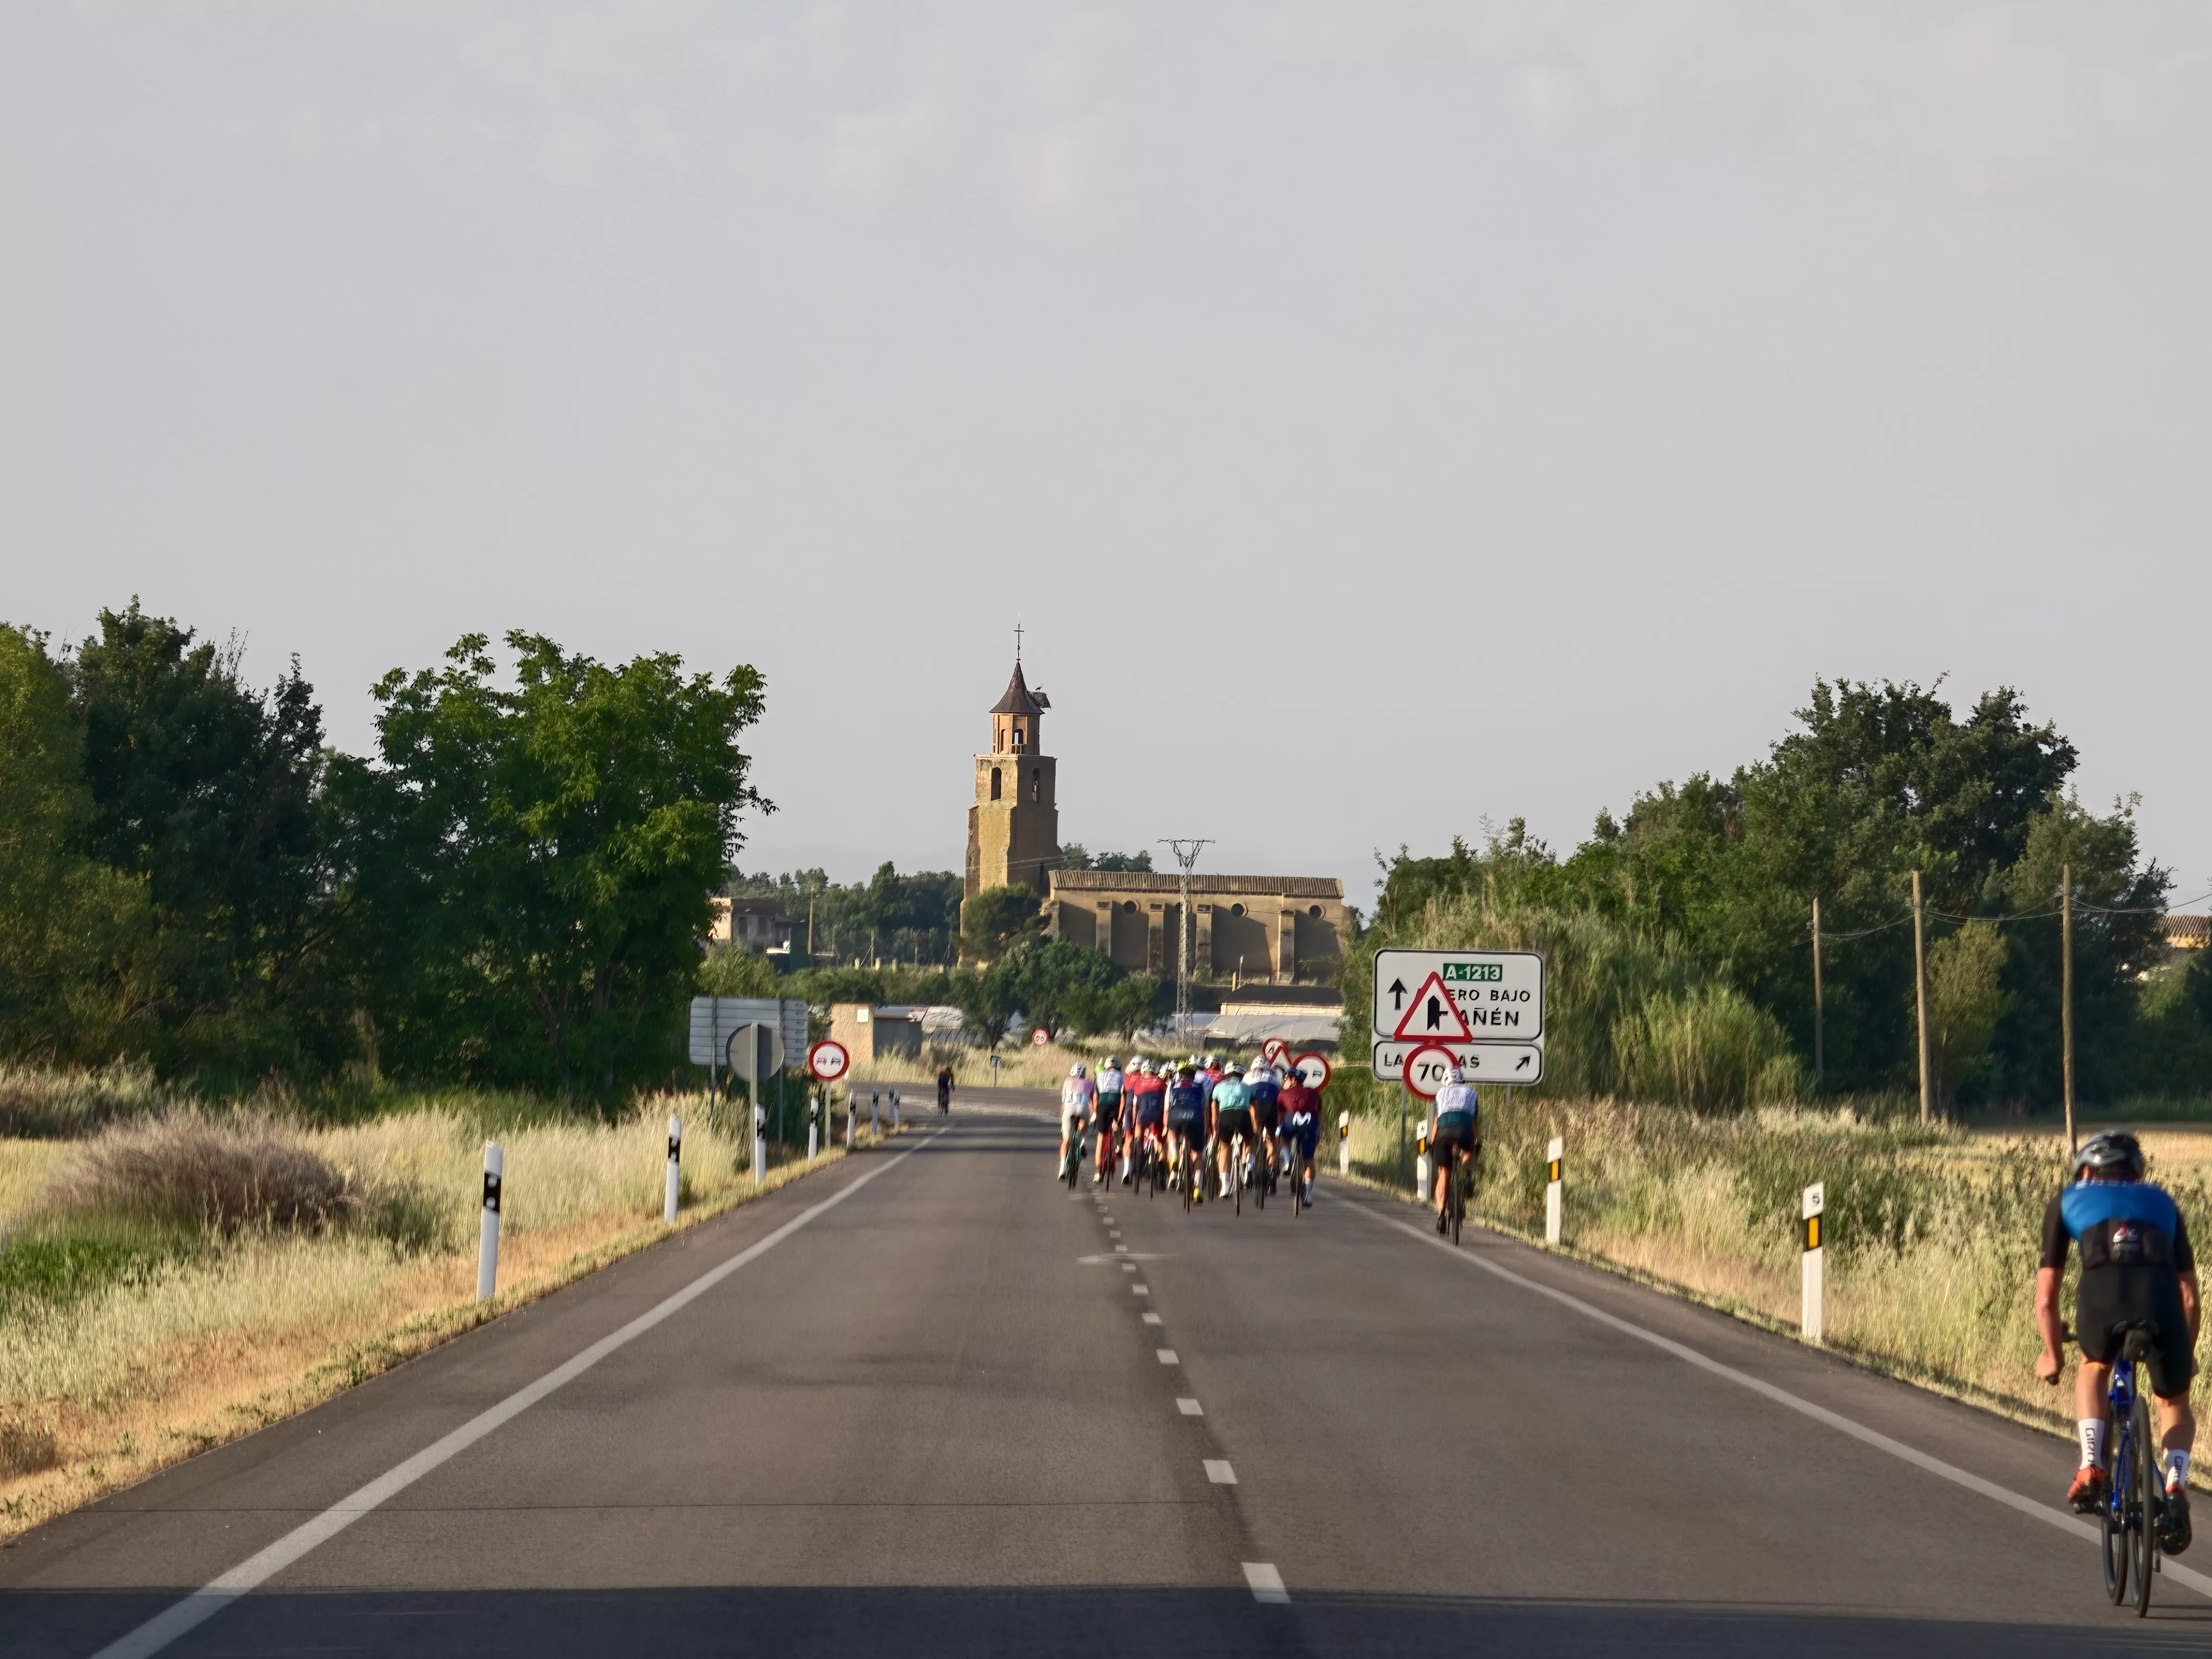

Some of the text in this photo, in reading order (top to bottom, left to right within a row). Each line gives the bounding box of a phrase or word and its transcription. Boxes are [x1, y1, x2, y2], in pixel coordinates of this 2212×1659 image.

[1445, 965, 1500, 980] A-1213
[1490, 989, 1530, 1002] BAJO
[1458, 1007, 1519, 1026] AÑÉN
[1417, 1062, 1445, 1082] 70
[2085, 1427, 2095, 1463] GIRO
